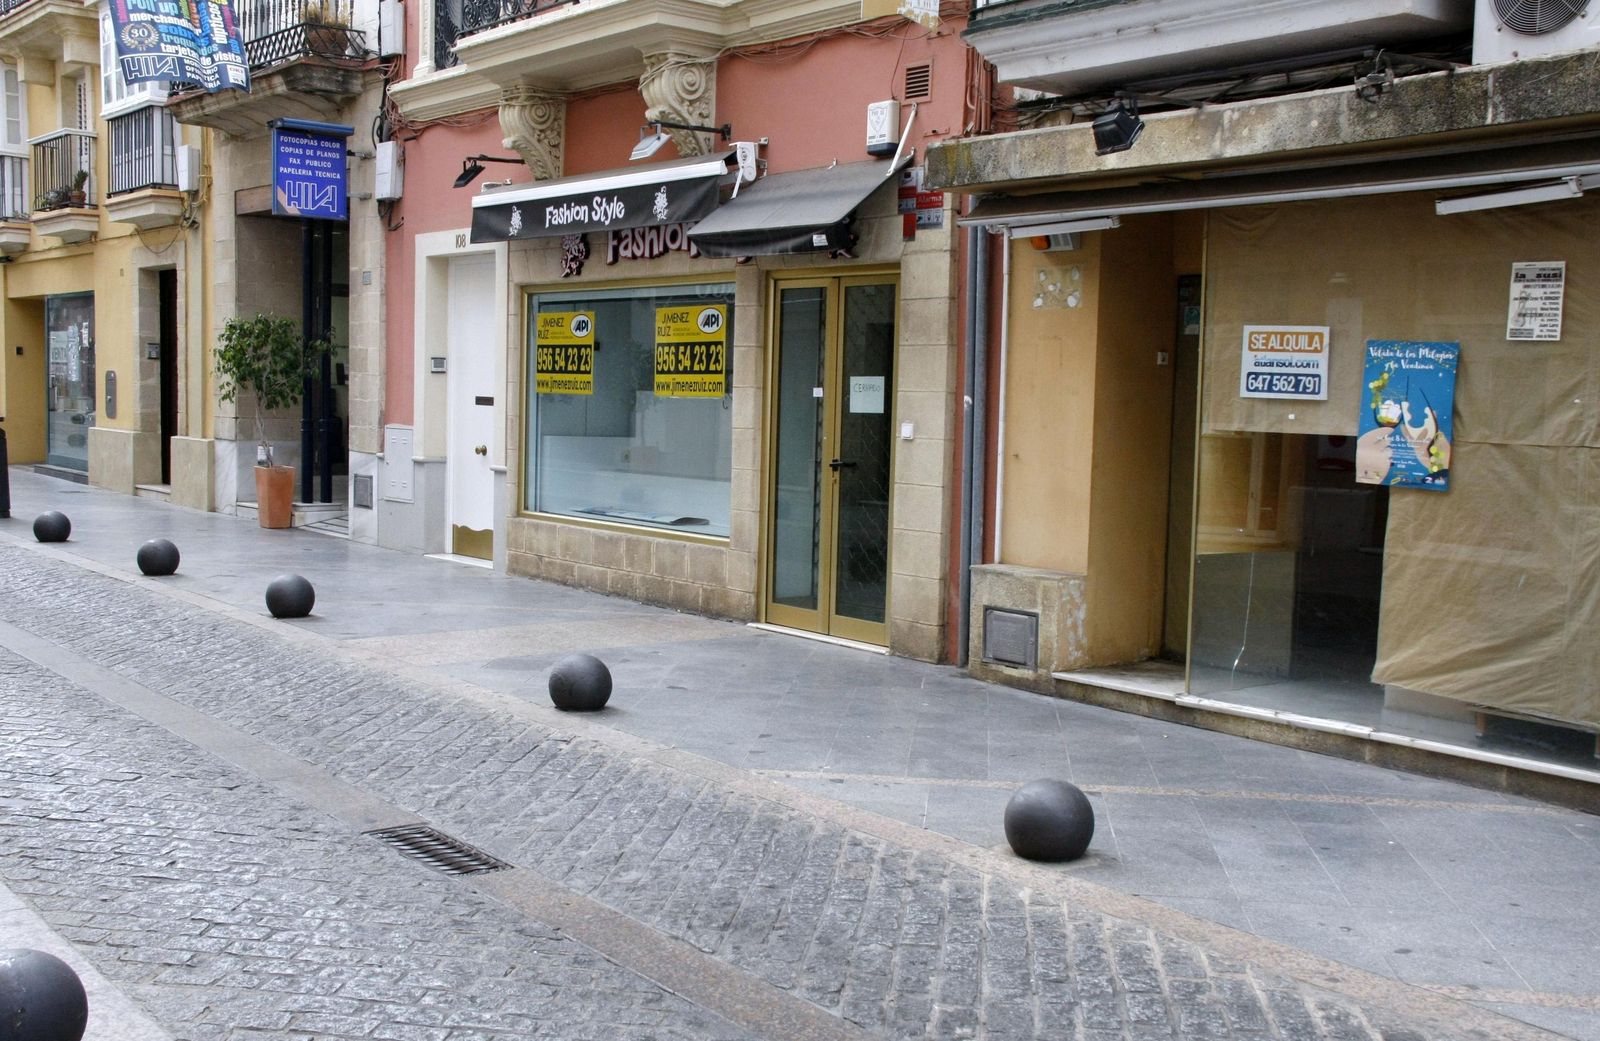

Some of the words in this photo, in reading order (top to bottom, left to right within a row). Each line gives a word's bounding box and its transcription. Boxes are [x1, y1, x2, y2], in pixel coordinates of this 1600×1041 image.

[159, 3, 179, 16] up
[130, 27, 148, 38] 30
[201, 56, 211, 66] de
[213, 51, 242, 63] visita
[280, 135, 318, 147] FOTOCOPIAS
[320, 141, 341, 149] COLOR
[280, 146, 303, 154] COPIAS
[316, 150, 340, 159] PLANOS
[289, 157, 301, 165] FAX
[305, 159, 332, 168] PUBLICO
[279, 166, 313, 176] PAPELERIA
[315, 170, 341, 179] TECNICA
[545, 202, 589, 228] Fashion
[591, 196, 626, 226] Style
[455, 233, 467, 248] 108
[542, 317, 565, 328] JIMENEZ
[661, 311, 690, 324] JIMENEZ
[701, 313, 720, 328] API
[573, 319, 589, 333] API
[657, 325, 671, 337] RUIZ
[537, 328, 549, 340] RUIZ
[1250, 333, 1267, 349] SE
[1267, 333, 1321, 351] ALQUILA
[537, 347, 553, 371] 956
[554, 347, 566, 371] 54
[567, 347, 578, 371] 23
[580, 347, 591, 372] 23
[657, 345, 676, 371] 956
[678, 345, 691, 371] 54
[693, 345, 707, 371] 23
[709, 344, 723, 371] 23
[1405, 349, 1416, 359] los
[1418, 346, 1455, 361] Milagros
[537, 377, 592, 392] www.jimenezruiz.com
[655, 377, 723, 395] www.jimenezruiz.com
[1247, 374, 1271, 391] 647
[1272, 375, 1295, 392] 562
[1297, 376, 1319, 393] 791
